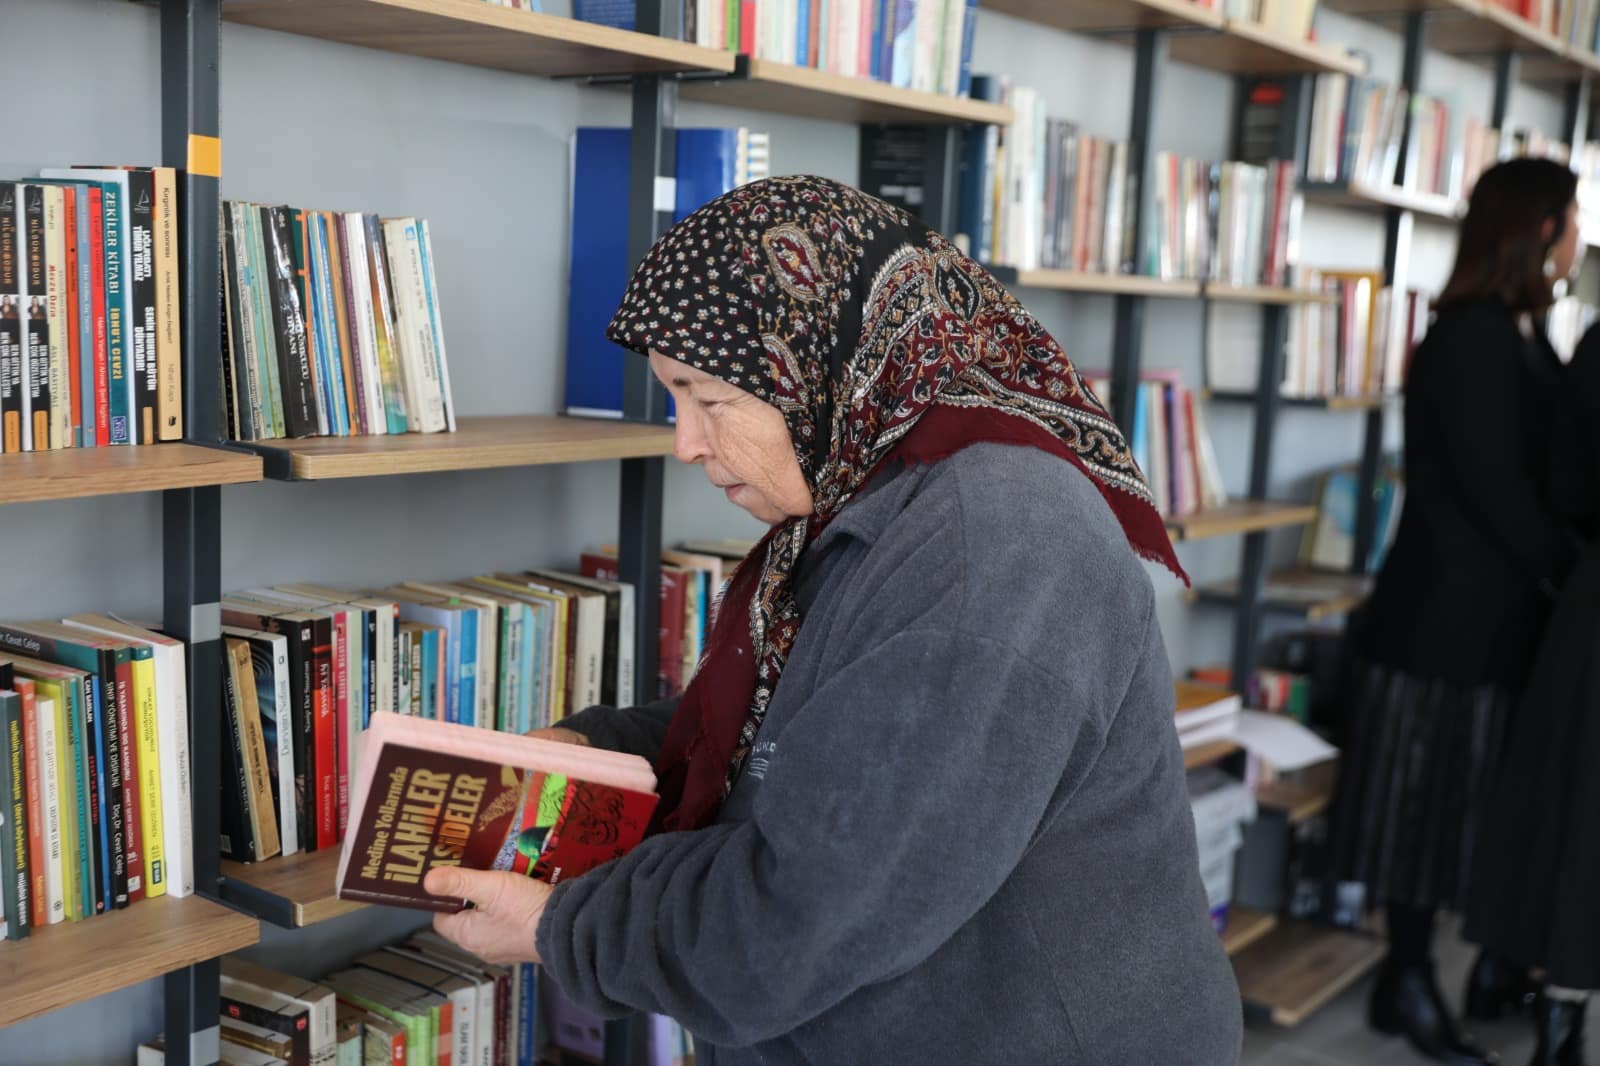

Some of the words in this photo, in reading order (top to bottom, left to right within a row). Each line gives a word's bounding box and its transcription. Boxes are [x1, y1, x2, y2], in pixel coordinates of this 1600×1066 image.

[105, 192, 118, 247] ZEKİLER
[108, 252, 120, 294] KİTABI
[134, 253, 144, 281] YILMAZ
[145, 307, 156, 331] SENİN
[112, 347, 123, 379] CEVZİ
[135, 327, 145, 371] DÜNYADIR!
[31, 358, 40, 398] GÜZELLEŞTİM
[147, 362, 157, 391] BÜTÜN
[106, 681, 115, 700] SINIF
[107, 703, 117, 741] YÖNETİMİ
[119, 690, 129, 732] YAŞAMINDA
[110, 742, 118, 752] VE
[111, 754, 120, 788] DİSİPLİNİ
[361, 830, 389, 879] Medine
[375, 767, 408, 829] Yollarında
[430, 774, 488, 867] SİDELER
[114, 832, 123, 853] Cevat
[115, 855, 124, 876] Celep
